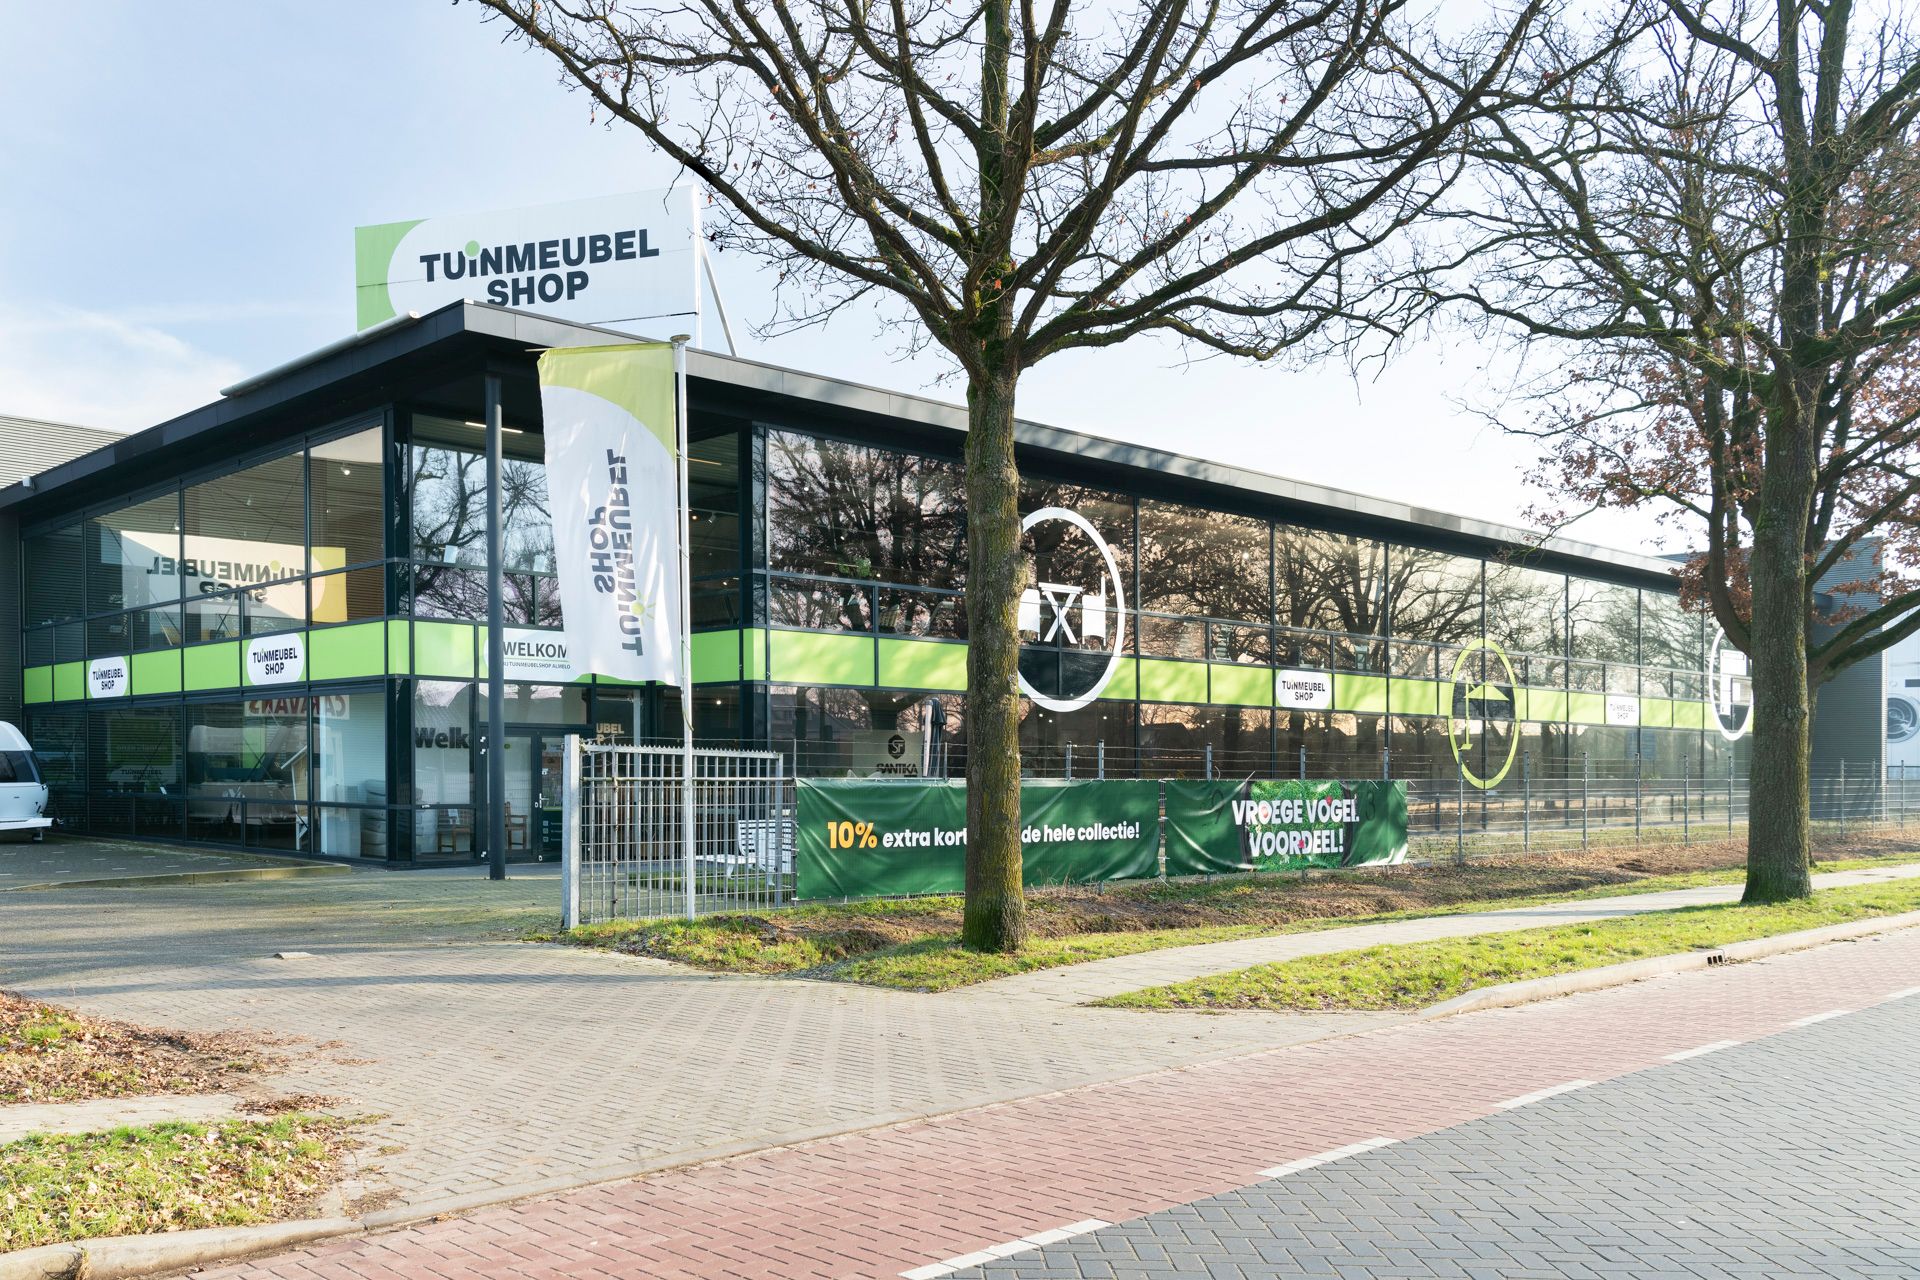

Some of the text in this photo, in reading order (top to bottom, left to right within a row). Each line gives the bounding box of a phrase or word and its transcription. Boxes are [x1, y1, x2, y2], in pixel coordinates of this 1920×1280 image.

[487, 270, 589, 308] SHOP
[265, 662, 285, 675] SHOP
[101, 680, 114, 690] SHOP
[1295, 691, 1314, 701] SHOP
[1231, 800, 1303, 826] VROEGE
[827, 821, 878, 849] 10%
[882, 829, 931, 848] extra
[1043, 823, 1076, 842] hele
[1077, 821, 1140, 841] collectie!
[1250, 829, 1344, 857] VOORDEEL!
